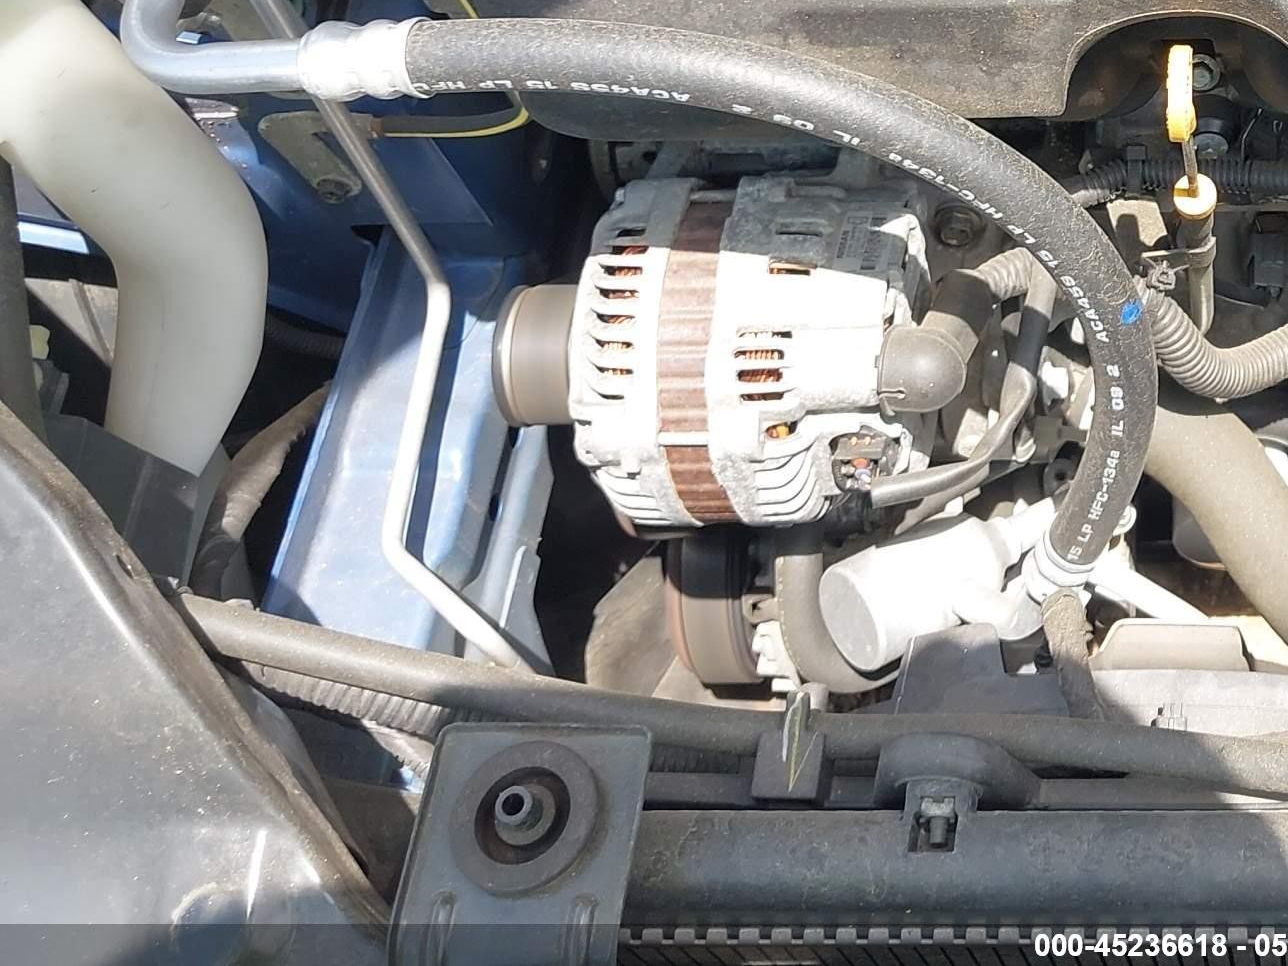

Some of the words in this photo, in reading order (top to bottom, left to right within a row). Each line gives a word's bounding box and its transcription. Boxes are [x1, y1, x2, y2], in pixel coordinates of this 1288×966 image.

[479, 78, 513, 90] LP
[526, 79, 559, 91] 15
[731, 103, 753, 115] 2
[773, 113, 815, 132] 09
[832, 128, 861, 146] IL
[888, 152, 1004, 221] HFC-134a
[1007, 224, 1037, 245] LP
[1037, 249, 1060, 269] 15
[1106, 364, 1121, 378] 2
[1110, 386, 1125, 411] 09
[1111, 419, 1125, 438] IL
[1087, 449, 1121, 522] HFC-134a
[1077, 525, 1095, 549] LP
[1067, 545, 1083, 562] 15
